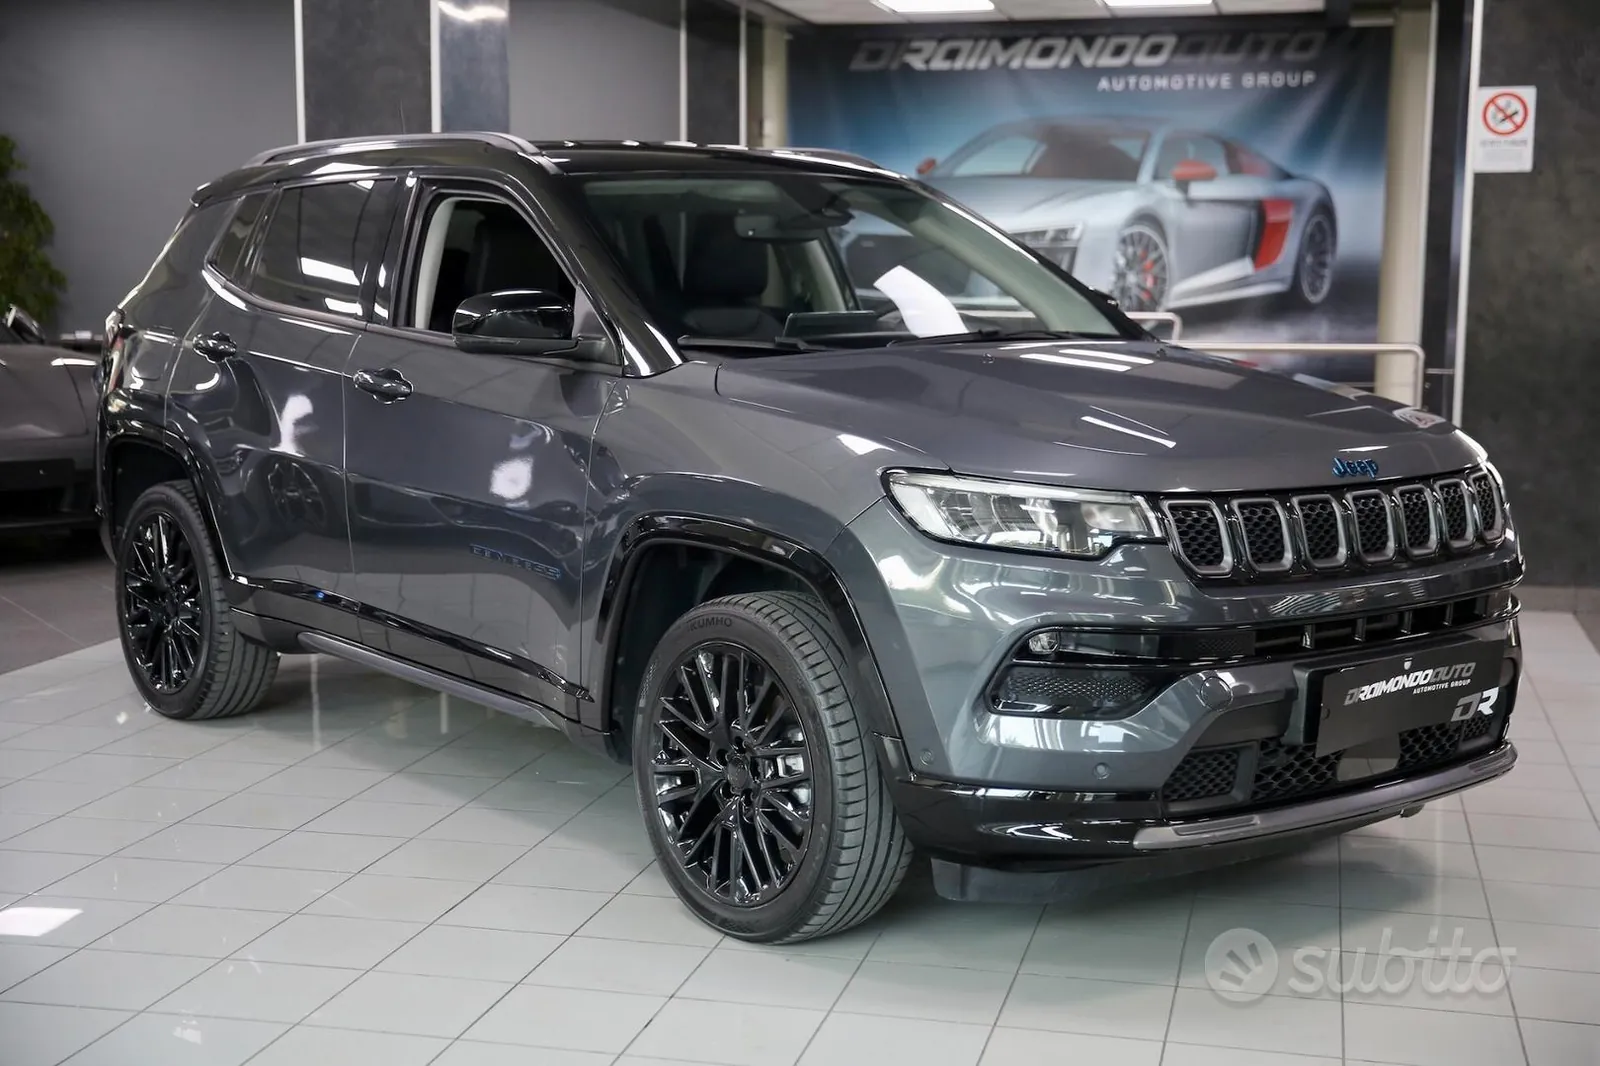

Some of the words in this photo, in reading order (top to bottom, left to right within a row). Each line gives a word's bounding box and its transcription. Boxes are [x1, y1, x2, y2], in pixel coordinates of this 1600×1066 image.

[1096, 74, 1231, 92] AUTOMOTIVE
[1241, 72, 1316, 88] GROUP
[1332, 457, 1379, 479] Jeep
[688, 616, 733, 632] KUMHO
[1412, 682, 1449, 695] AUTOMOTIVE
[1450, 678, 1472, 688] GROUP
[1450, 687, 1500, 722] DR
